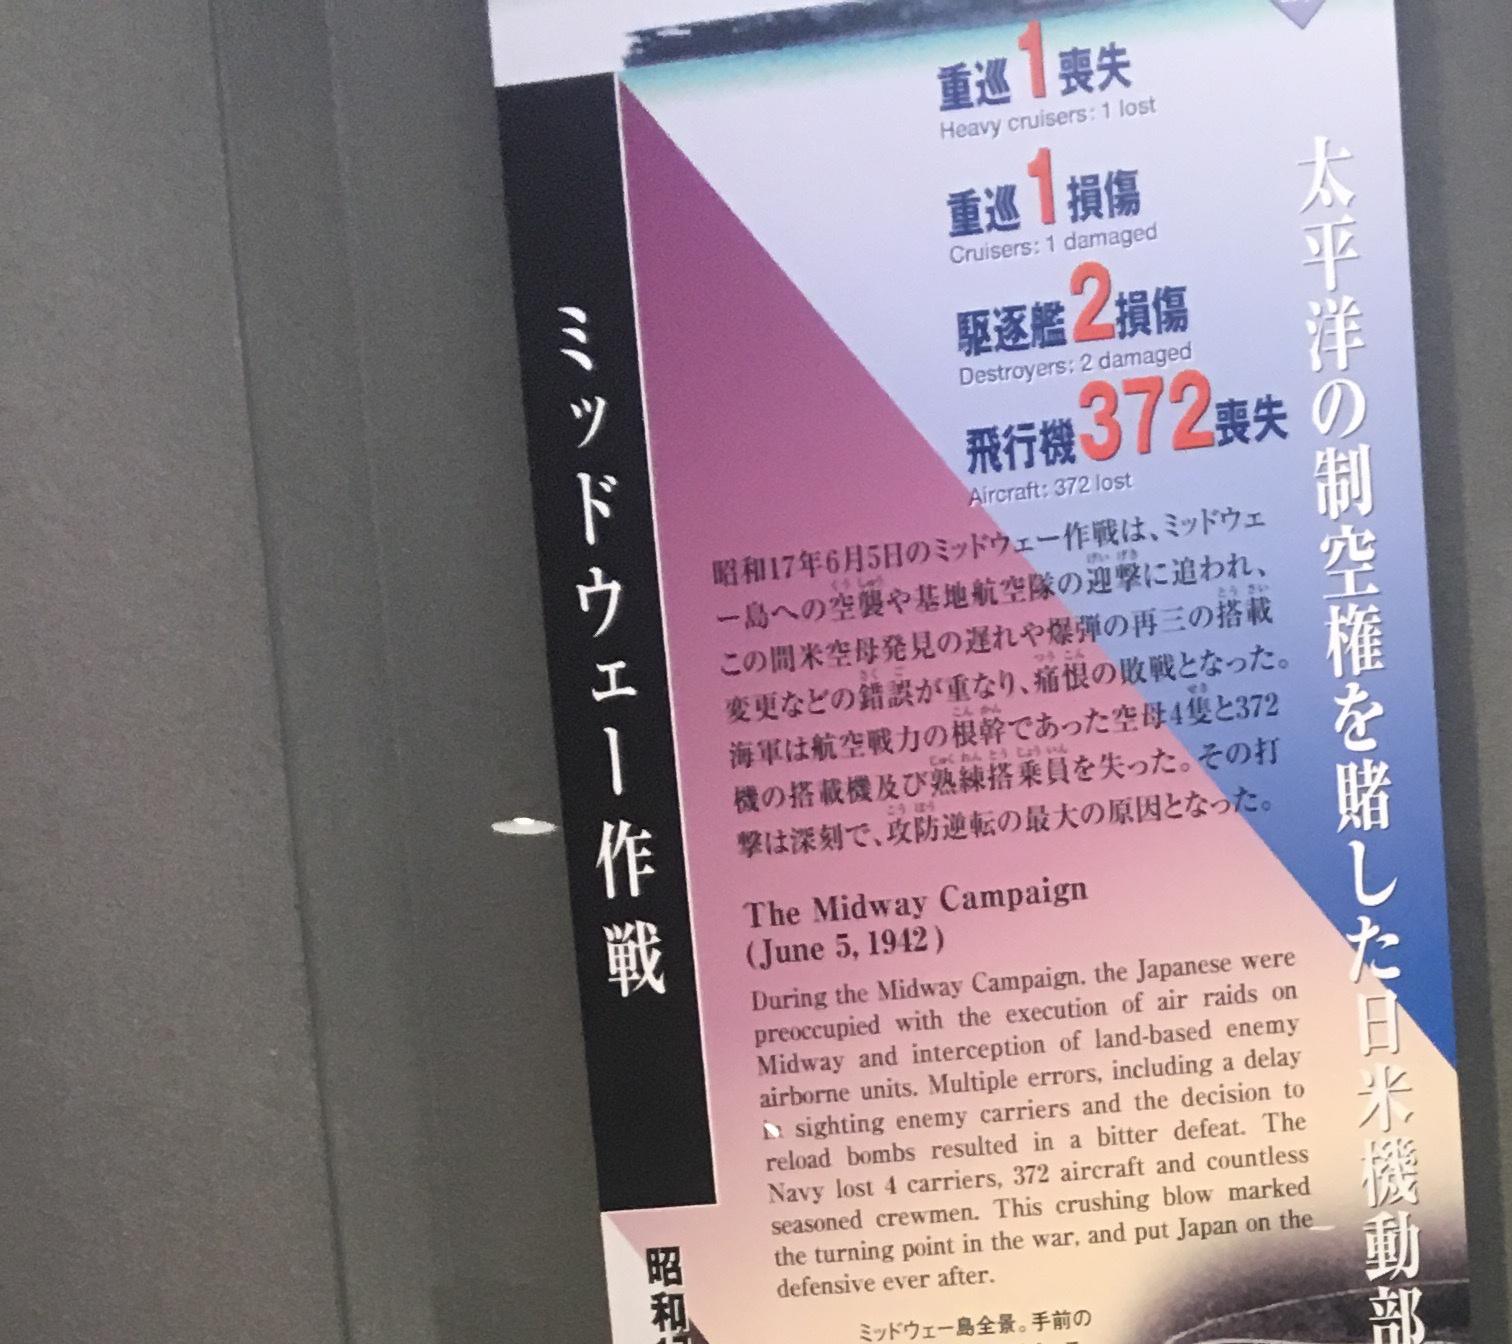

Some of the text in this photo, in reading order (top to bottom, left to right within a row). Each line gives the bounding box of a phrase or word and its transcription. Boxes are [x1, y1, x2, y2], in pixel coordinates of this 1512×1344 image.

[939, 97, 1157, 140] Heavy cruisers: 1 lost
[949, 222, 1158, 264] Cruisers: 1 damaged
[959, 341, 1192, 388] Destroyers: 2 damaged
[966, 368, 1289, 475] 飛行機372喪失
[969, 472, 1132, 507] Aircraft: 372 lost
[557, 305, 667, 998] ミッドウェー作戦
[742, 876, 1089, 928] The Midway Campaign
[746, 925, 945, 970] (June 5, 1942)
[752, 987, 828, 1013] During
[835, 983, 869, 1005] the
[877, 977, 963, 1001] Midway
[1095, 961, 1128, 984] the
[1136, 955, 1232, 984] Japanese
[1240, 951, 1296, 970] were
[754, 983, 1298, 1048] preoccupied with the execution of air raids on
[757, 1015, 1300, 1077] Midway and interception of land-based enemy
[859, 1308, 1093, 1342] ミッドウェー島全景。手前の
